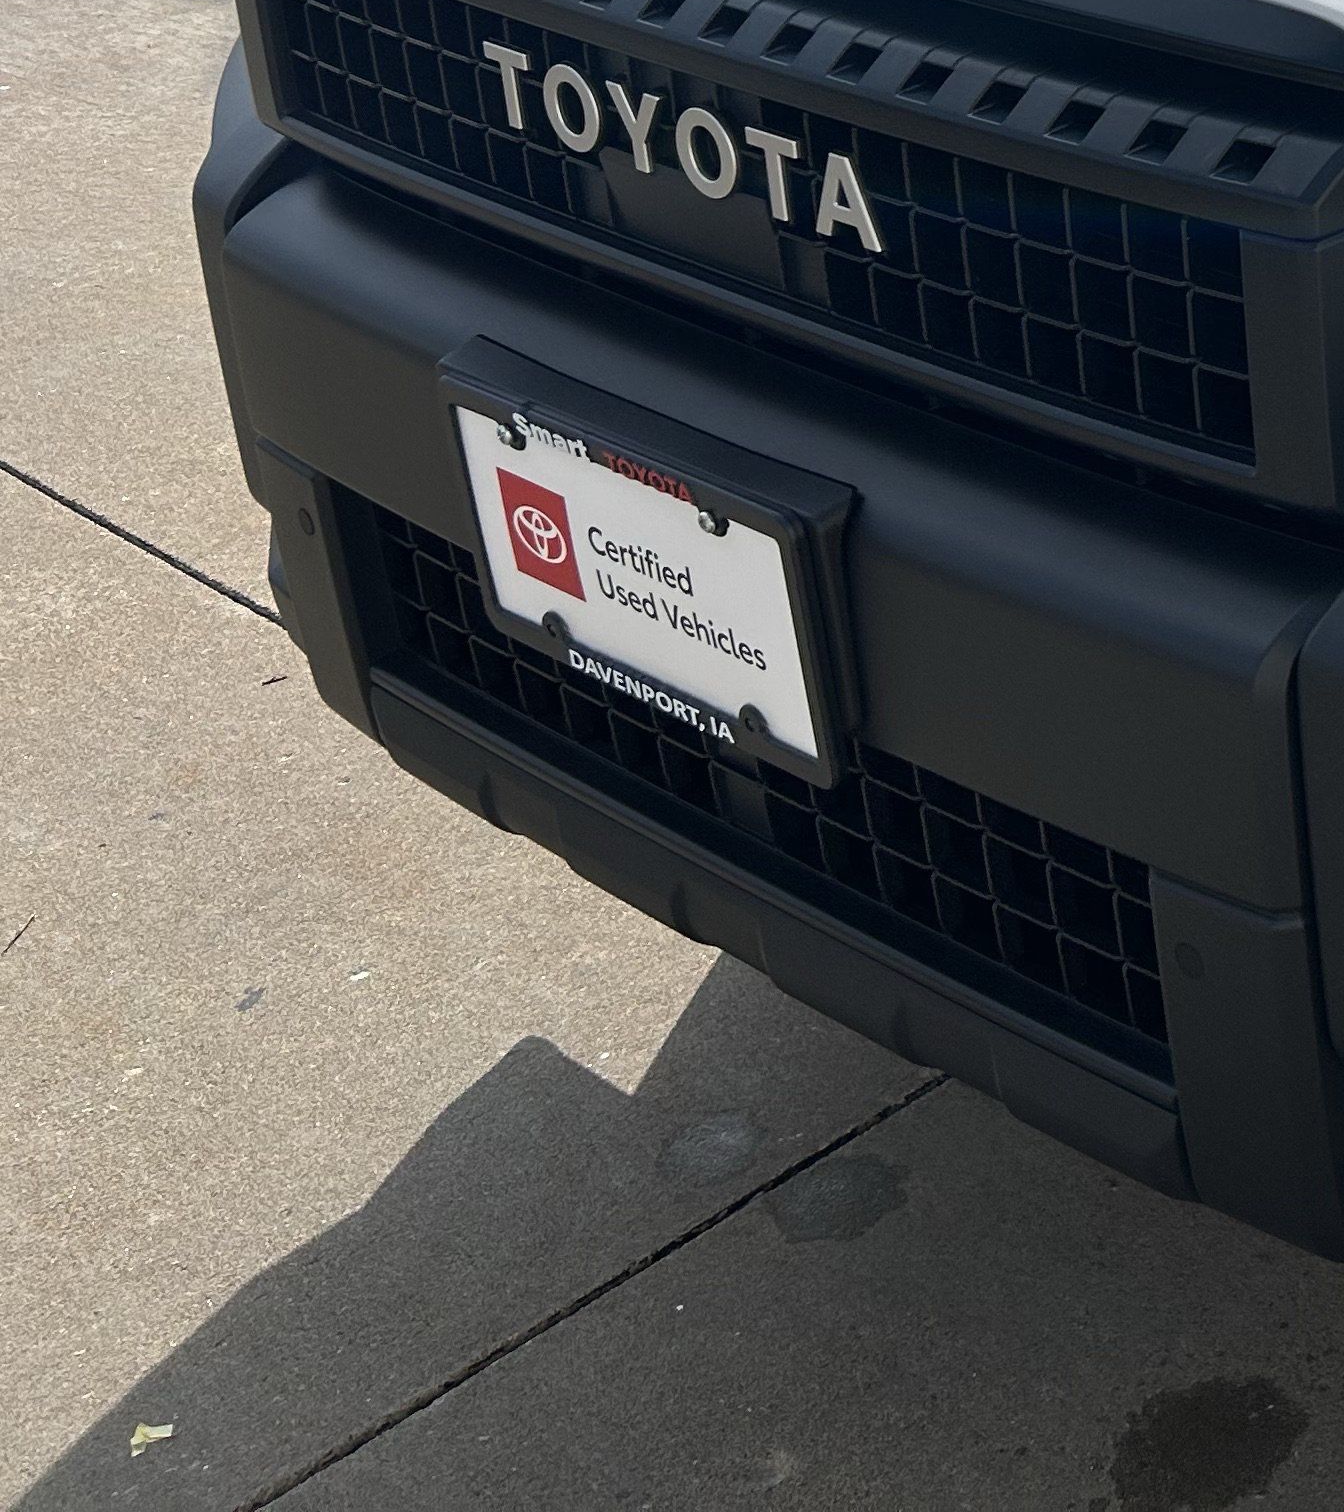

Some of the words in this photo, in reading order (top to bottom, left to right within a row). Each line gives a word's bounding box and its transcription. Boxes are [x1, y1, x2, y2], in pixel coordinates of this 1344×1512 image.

[482, 40, 883, 254] TOYOTA
[512, 412, 588, 458] Smart
[602, 451, 692, 504] TOYOTA
[587, 526, 694, 597] Certified
[596, 568, 659, 621] Used
[661, 597, 767, 671] Vehicles
[568, 649, 706, 732] DAVENPORT,
[709, 716, 736, 744] IA
